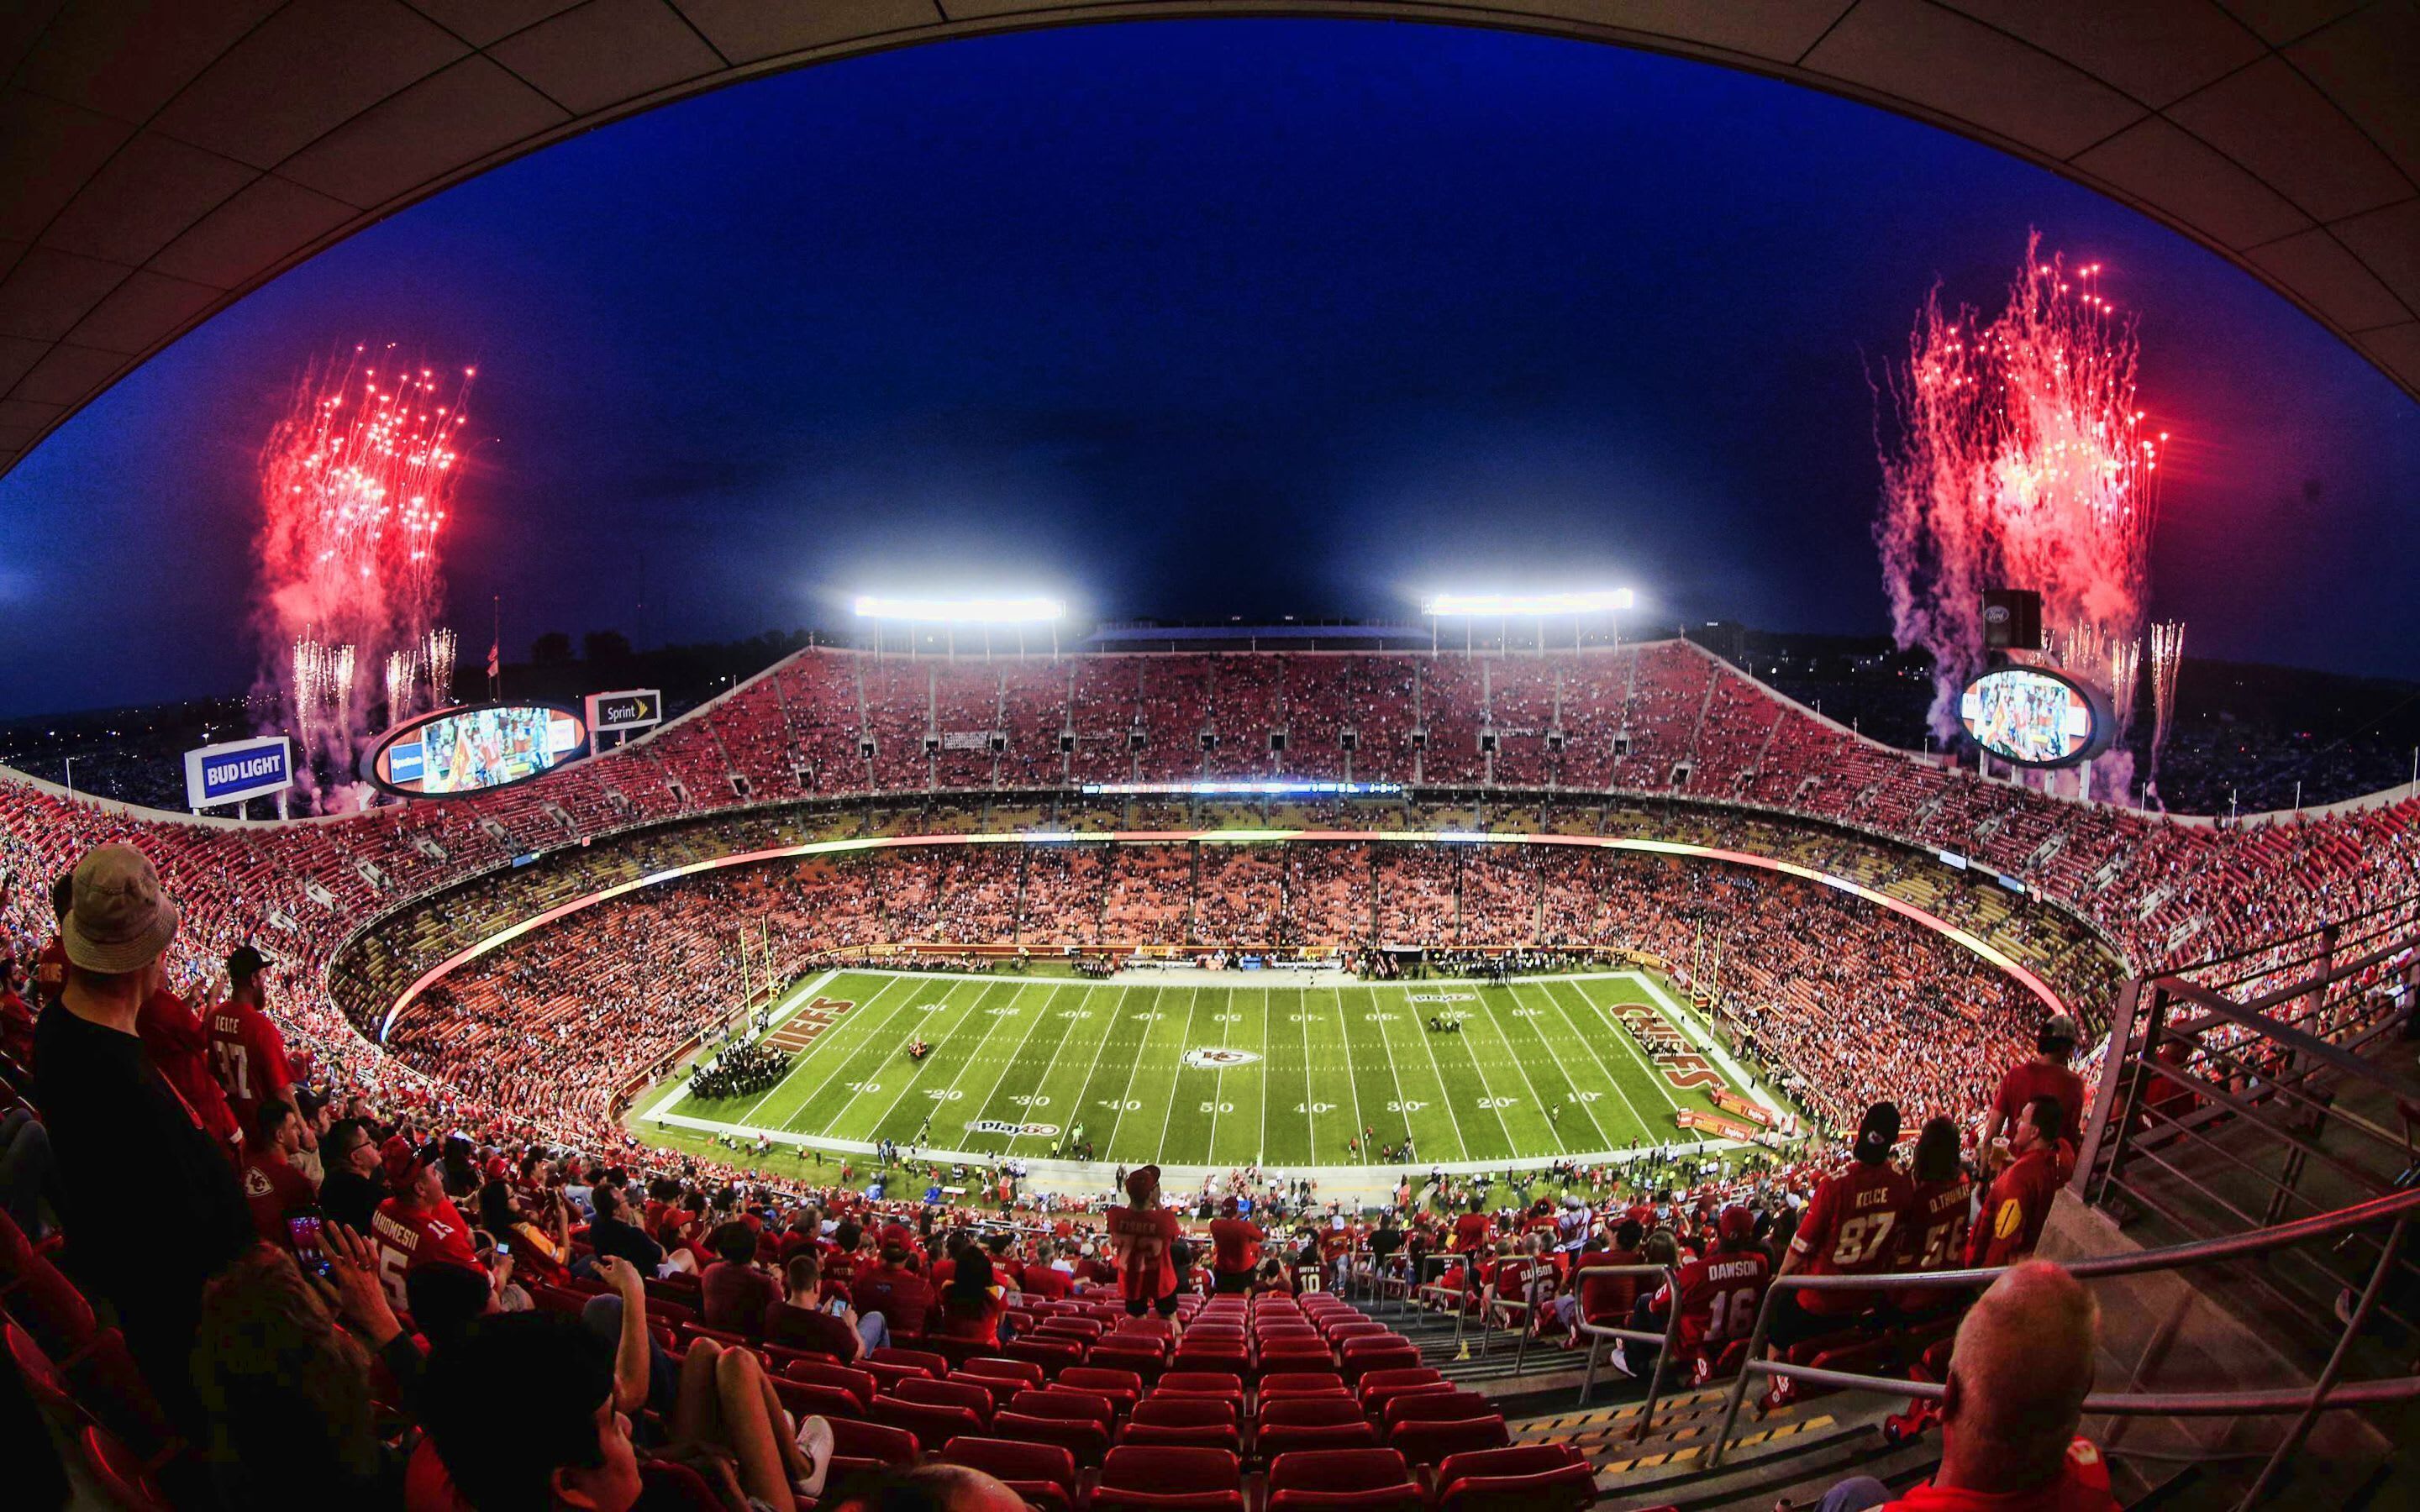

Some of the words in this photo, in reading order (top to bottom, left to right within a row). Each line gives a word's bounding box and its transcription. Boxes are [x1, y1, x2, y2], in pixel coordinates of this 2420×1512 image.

[1988, 609, 2004, 619] Ford
[608, 705, 635, 722] Sprint
[207, 764, 239, 786] BUD
[239, 755, 281, 779] LIGHT
[214, 1015, 239, 1034] KELCE
[850, 1081, 881, 1093] 10
[929, 1089, 964, 1100] 20
[1016, 1095, 1051, 1106] 30
[1566, 1091, 1597, 1103] 10
[1107, 1100, 1142, 1111] 40
[1199, 1102, 1234, 1114] 50
[1292, 1102, 1328, 1114] 40
[1386, 1100, 1420, 1112] 30
[1476, 1096, 1512, 1109] 20
[1855, 1187, 1889, 1210] KELCE
[1833, 1211, 1896, 1264] 87
[1708, 1261, 1758, 1282] DAWSON
[1300, 1273, 1320, 1294] 10
[1703, 1288, 1756, 1341] 16
